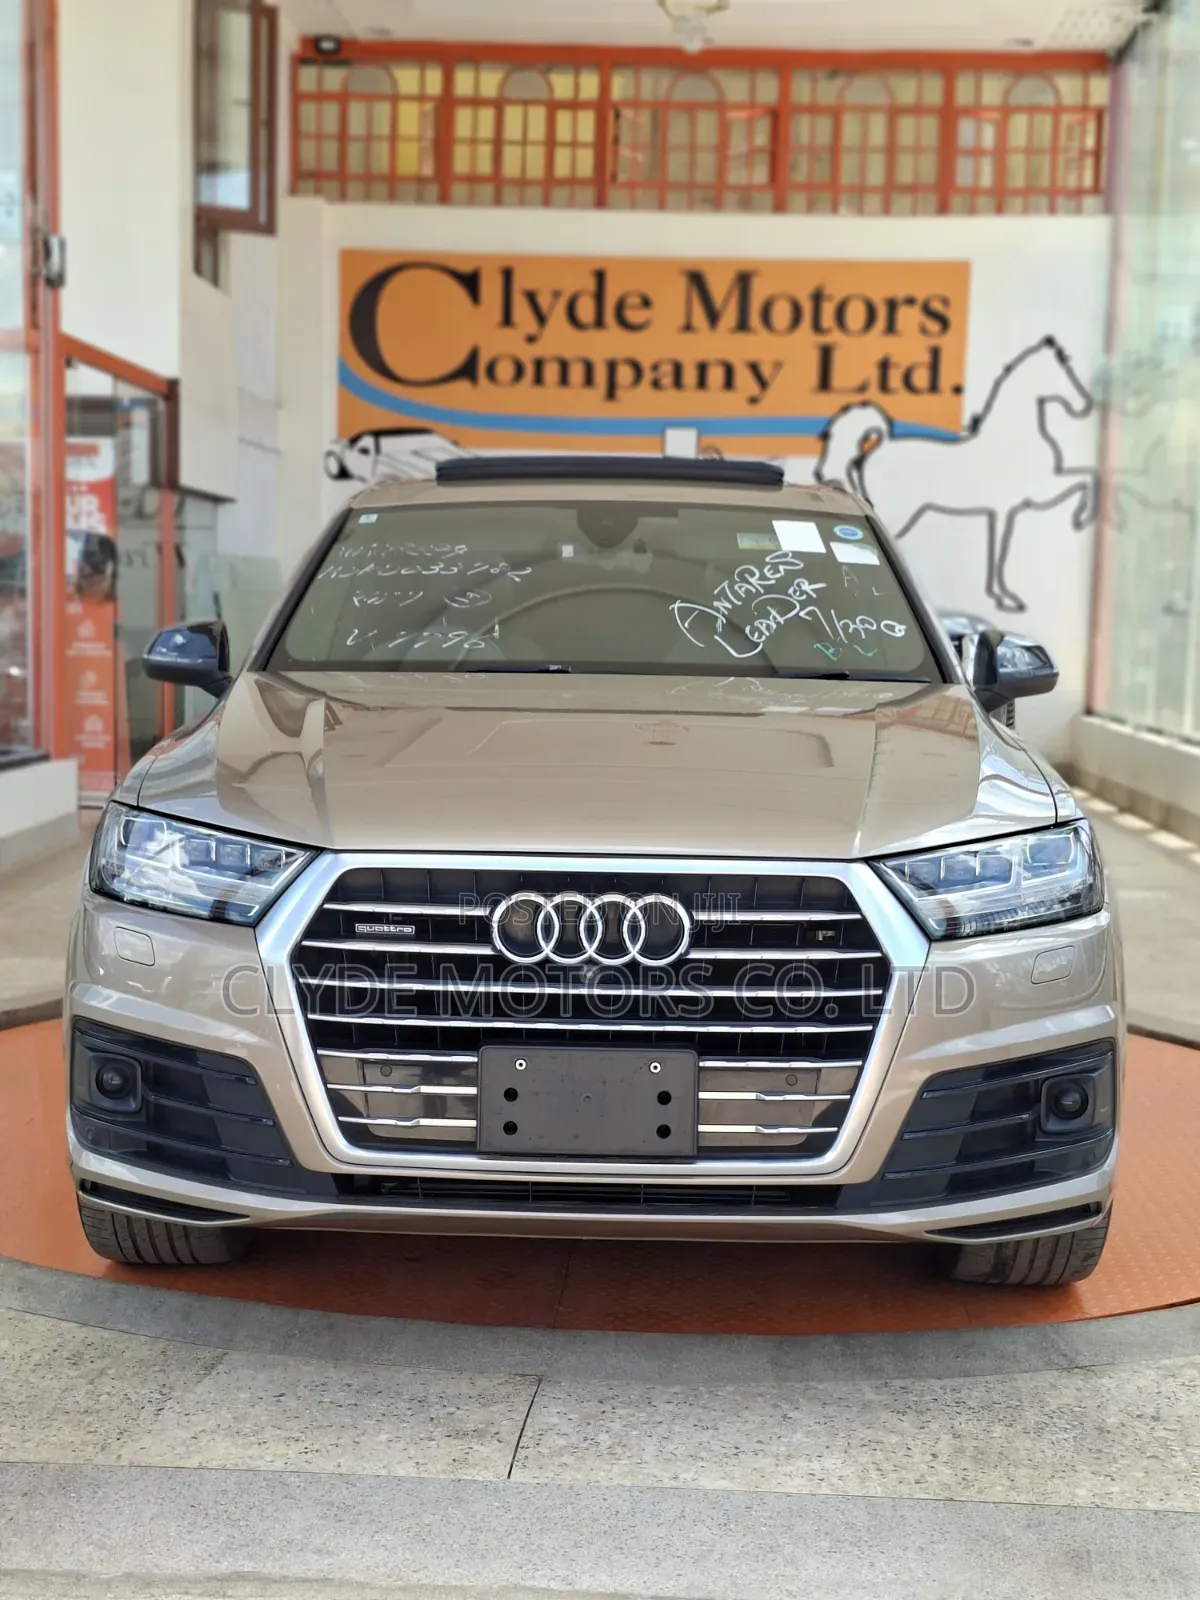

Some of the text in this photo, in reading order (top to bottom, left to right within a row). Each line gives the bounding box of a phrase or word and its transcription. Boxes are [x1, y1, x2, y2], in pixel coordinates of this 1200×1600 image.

[349, 261, 952, 387] Clyde Motors
[815, 343, 965, 396] Ltd.
[356, 923, 414, 935] quattro
